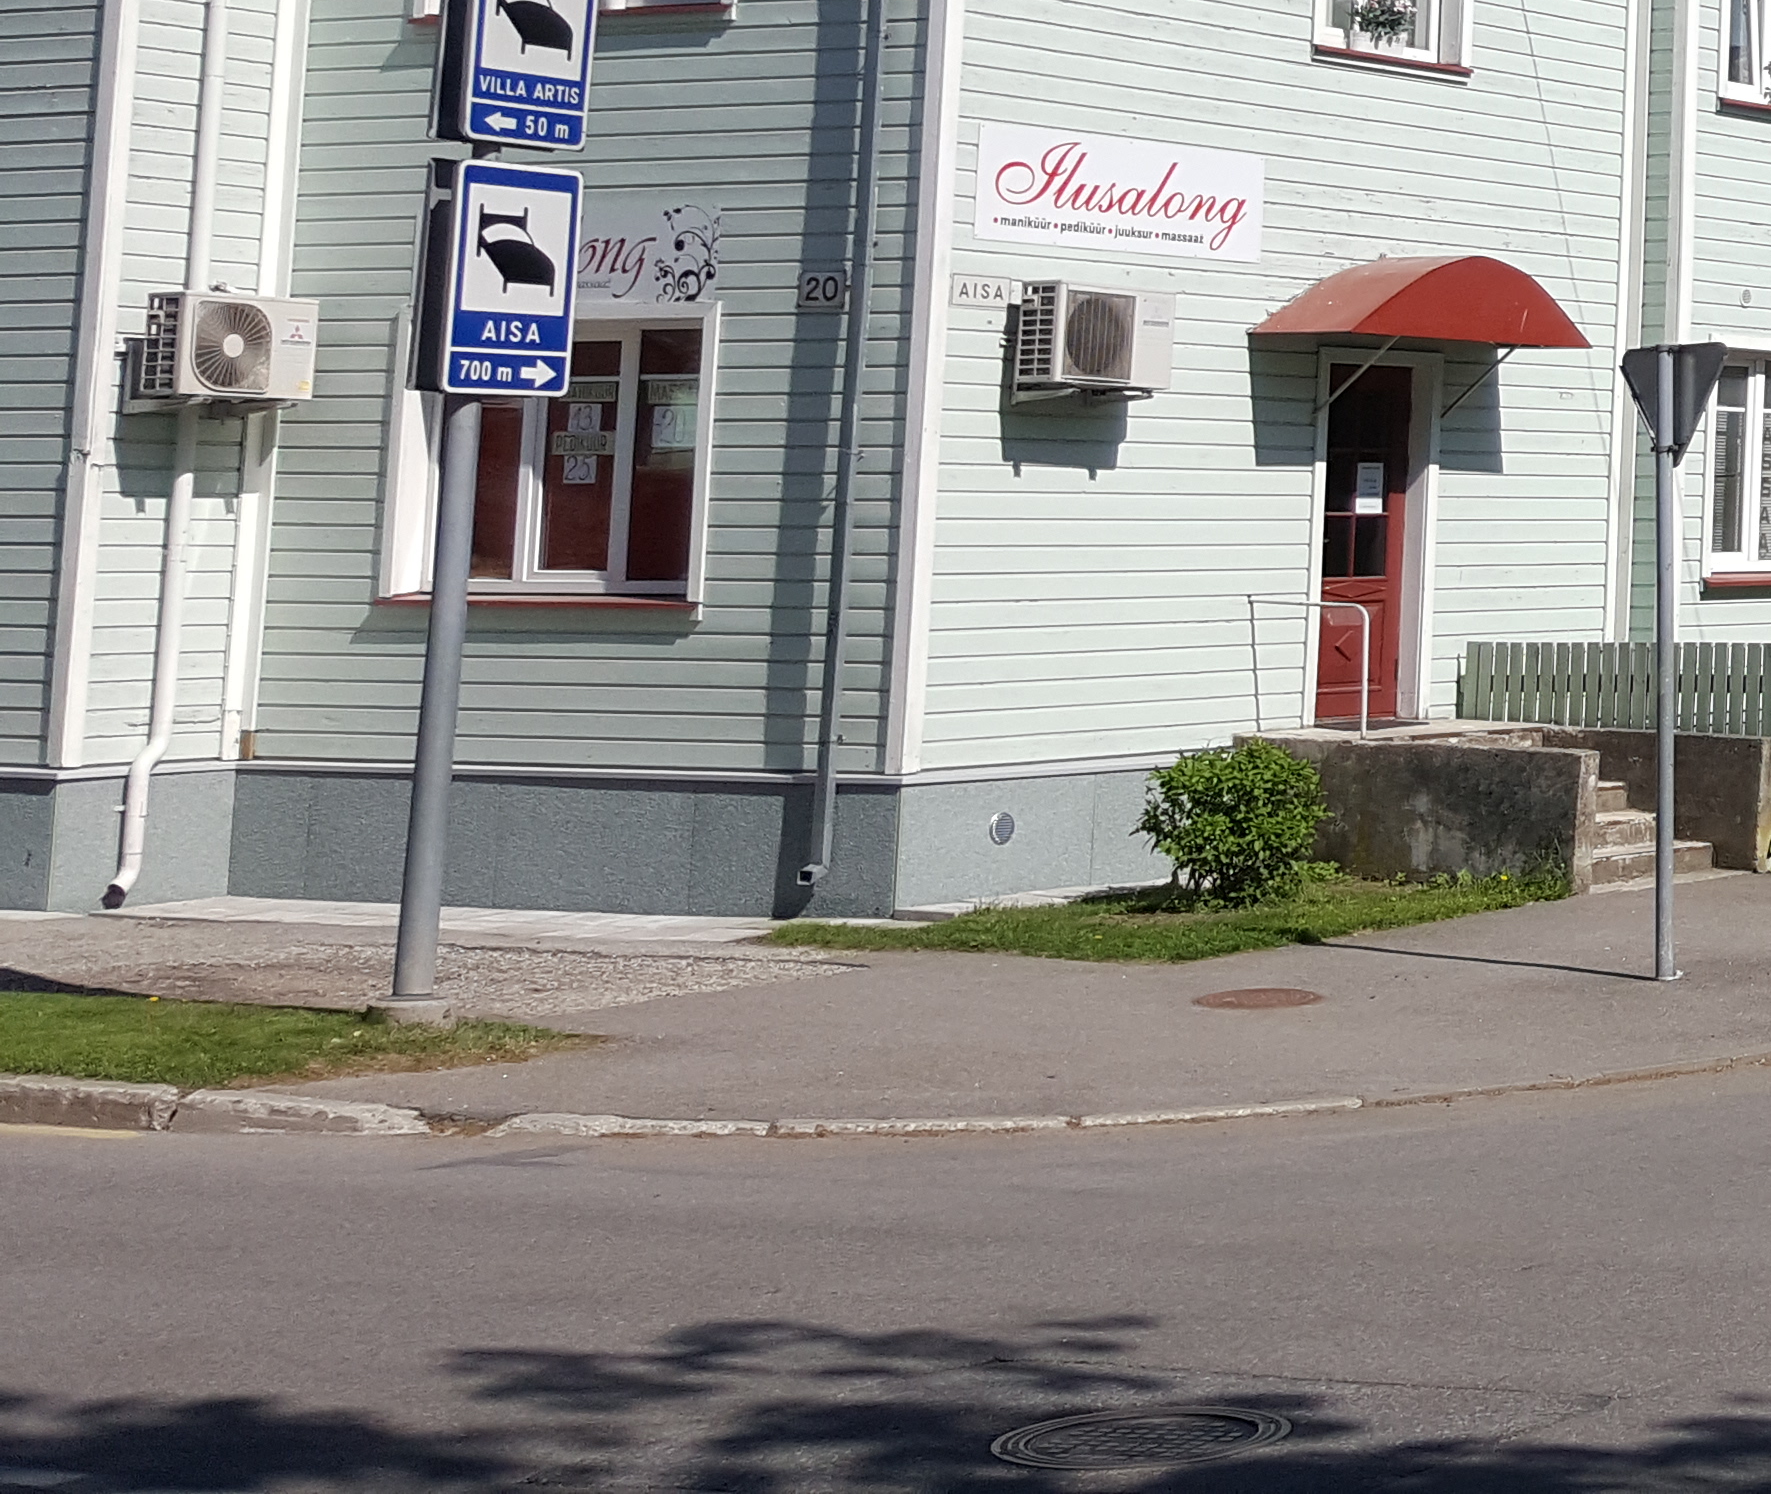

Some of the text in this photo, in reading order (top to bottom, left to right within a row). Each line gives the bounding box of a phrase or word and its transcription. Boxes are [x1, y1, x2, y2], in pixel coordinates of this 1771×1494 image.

[479, 74, 580, 104] VILLA ARTIS
[524, 115, 569, 140] 50 m
[995, 142, 1247, 251] Ilusalong
[1000, 216, 1052, 230] maniküür
[1060, 220, 1107, 235] pediküür
[1114, 225, 1153, 240] juuksur
[805, 276, 839, 302] 20
[958, 281, 1004, 301] AISA
[481, 319, 541, 344] AISA
[459, 359, 512, 383] 700 m
